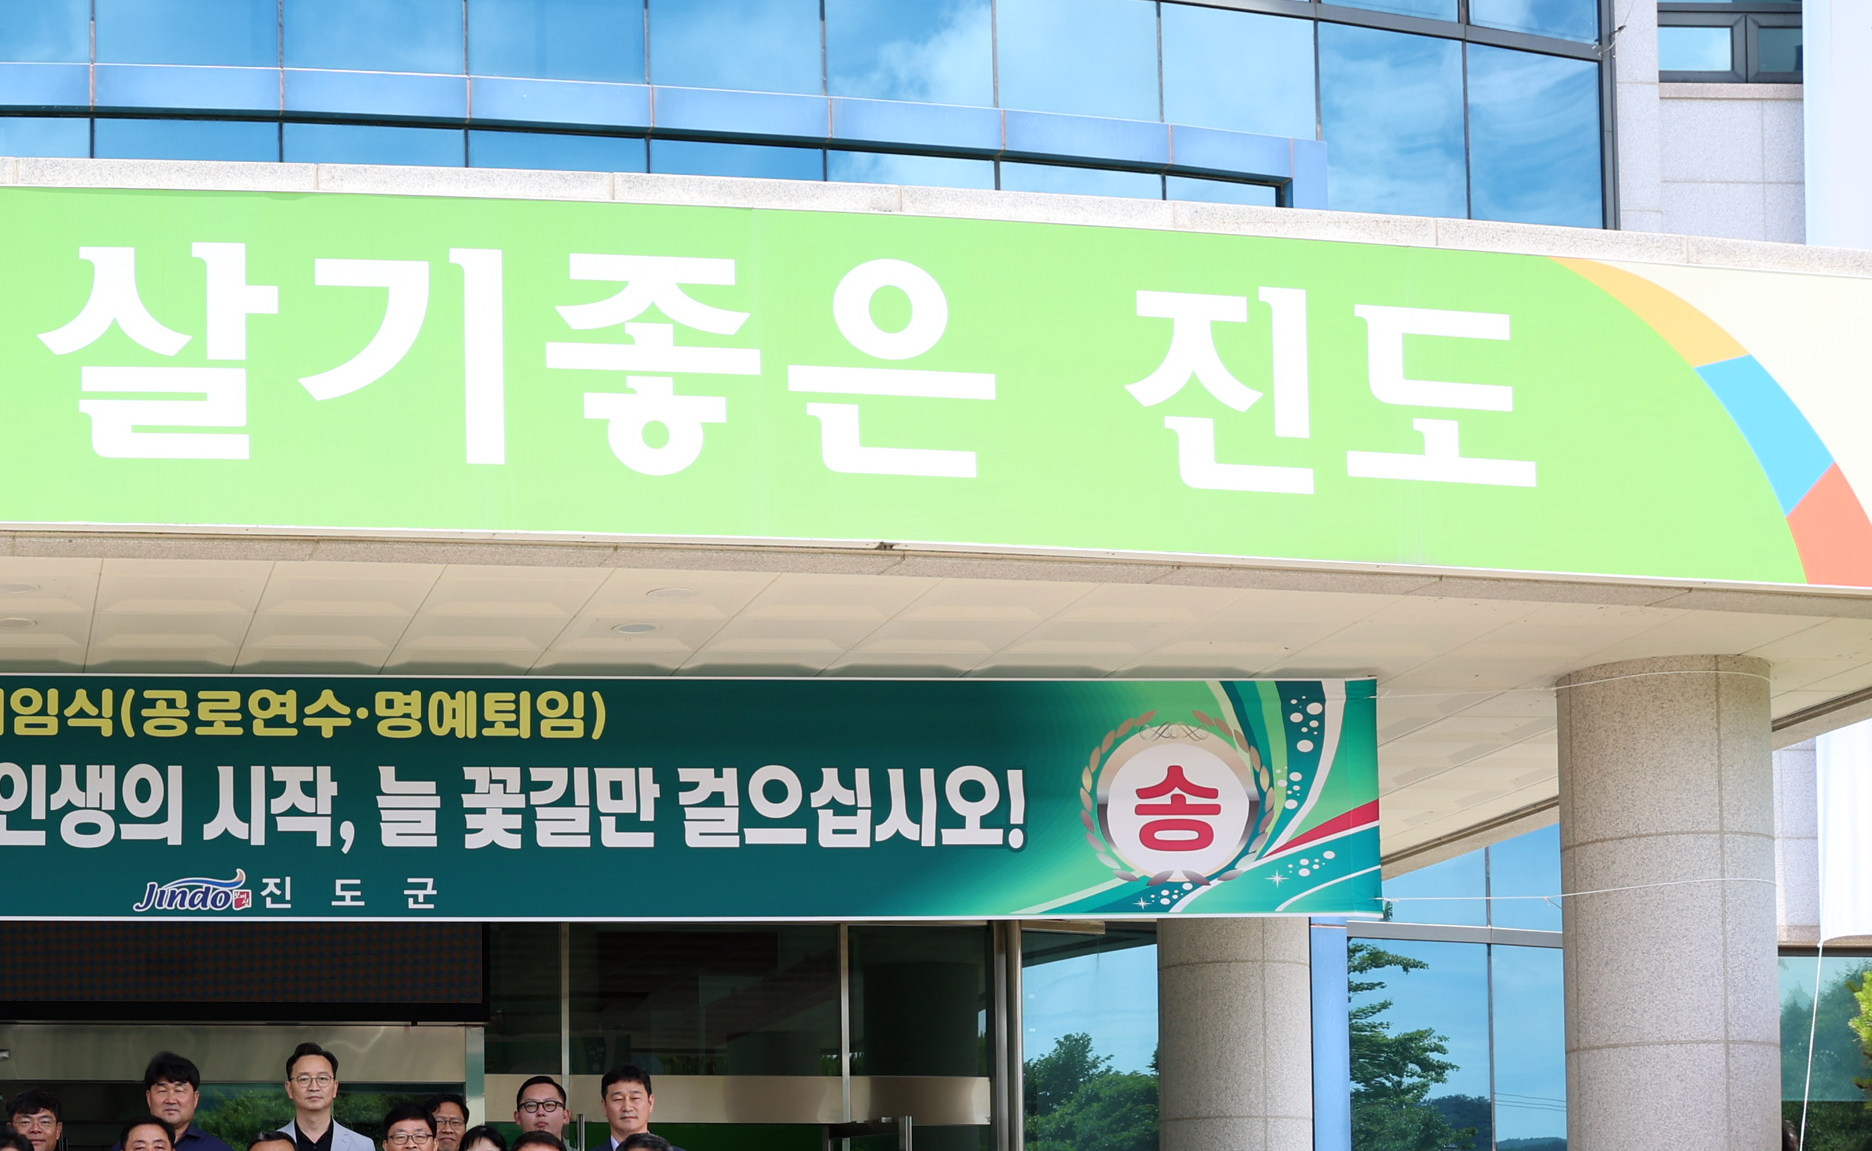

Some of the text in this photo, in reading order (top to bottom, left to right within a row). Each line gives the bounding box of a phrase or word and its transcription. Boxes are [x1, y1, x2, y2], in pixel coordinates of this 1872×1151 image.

[38, 242, 996, 478] 살기좋은
[1125, 287, 1536, 494] 진도
[204, 766, 354, 854] 시작,
[376, 766, 441, 847] 늘
[462, 767, 660, 849] 꽃길만
[678, 765, 1025, 849] 걸으십시오!
[1135, 765, 1222, 852] 송
[133, 881, 232, 911] Jindo
